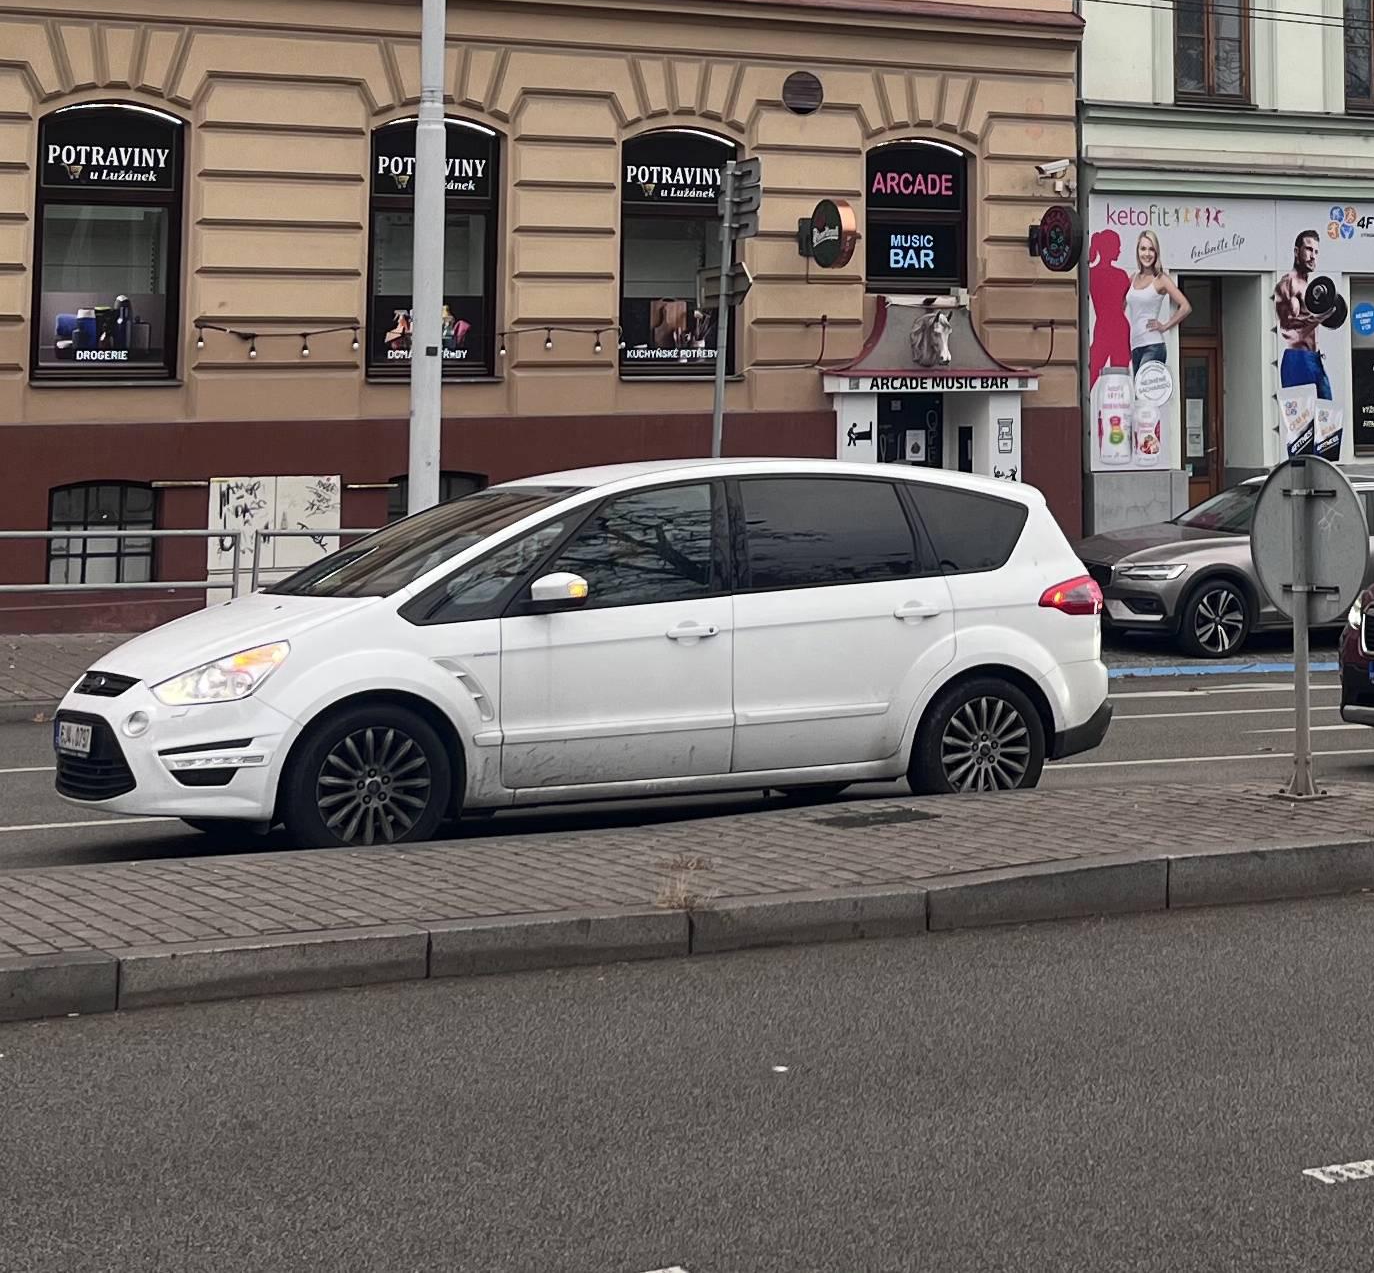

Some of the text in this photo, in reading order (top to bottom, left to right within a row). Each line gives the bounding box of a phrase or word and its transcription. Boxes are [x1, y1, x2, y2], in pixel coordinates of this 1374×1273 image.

[47, 144, 170, 167] POTRAVINY
[377, 155, 487, 177] POTVINY
[90, 169, 157, 182] u Lužánek
[626, 165, 721, 185] POTRAVINY
[444, 179, 477, 191] ánek
[872, 172, 953, 195] ARCADE
[660, 187, 715, 198] u Lužánek
[1106, 202, 1170, 227] ketofit
[890, 234, 935, 248] MUSIC
[889, 249, 935, 269] BAR
[76, 350, 128, 360] DROGERIE
[626, 348, 719, 359] KUCHYŇSKÉ POTŘEBY
[869, 376, 1009, 390] ARCADE MUSIC BAR
